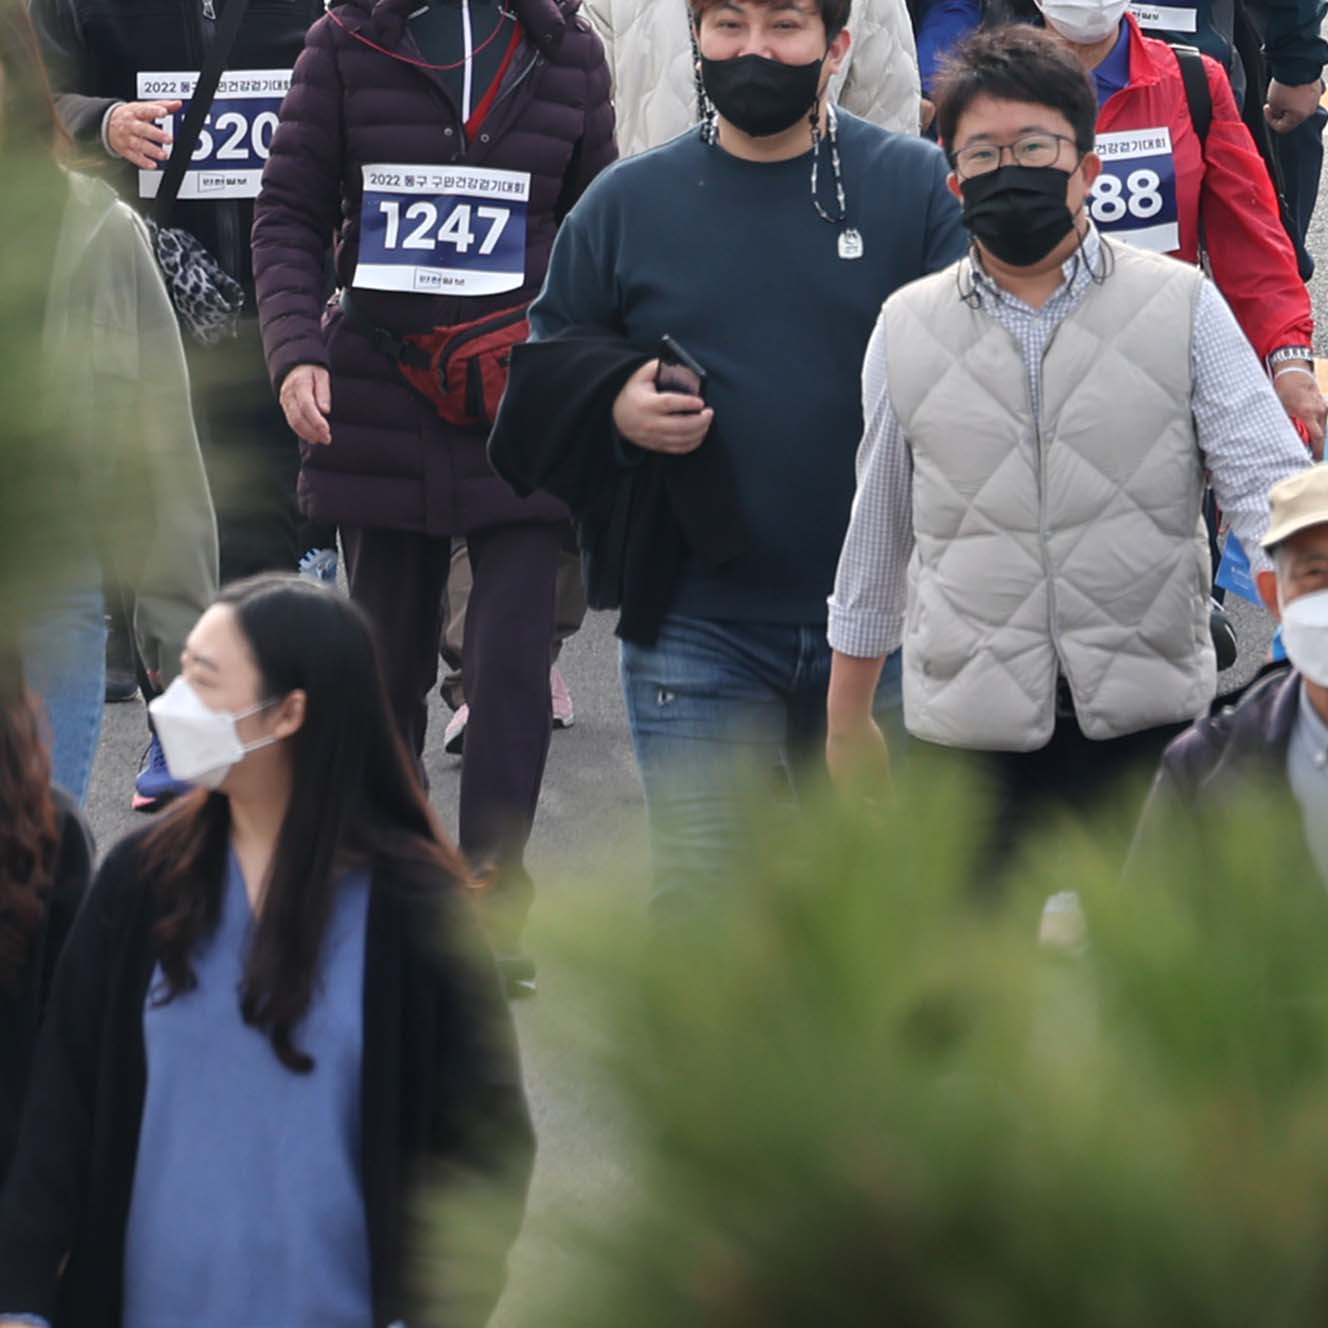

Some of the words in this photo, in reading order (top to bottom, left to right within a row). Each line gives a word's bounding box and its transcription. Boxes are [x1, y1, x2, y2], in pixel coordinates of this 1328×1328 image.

[144, 81, 177, 94] 2022
[1096, 138, 1166, 156] 건강걷기대회
[370, 174, 401, 187] 2022
[404, 175, 427, 188] 동구
[432, 175, 525, 195] 구민건강걷기대회
[1090, 169, 1163, 223] 88
[380, 201, 510, 255] 1247
